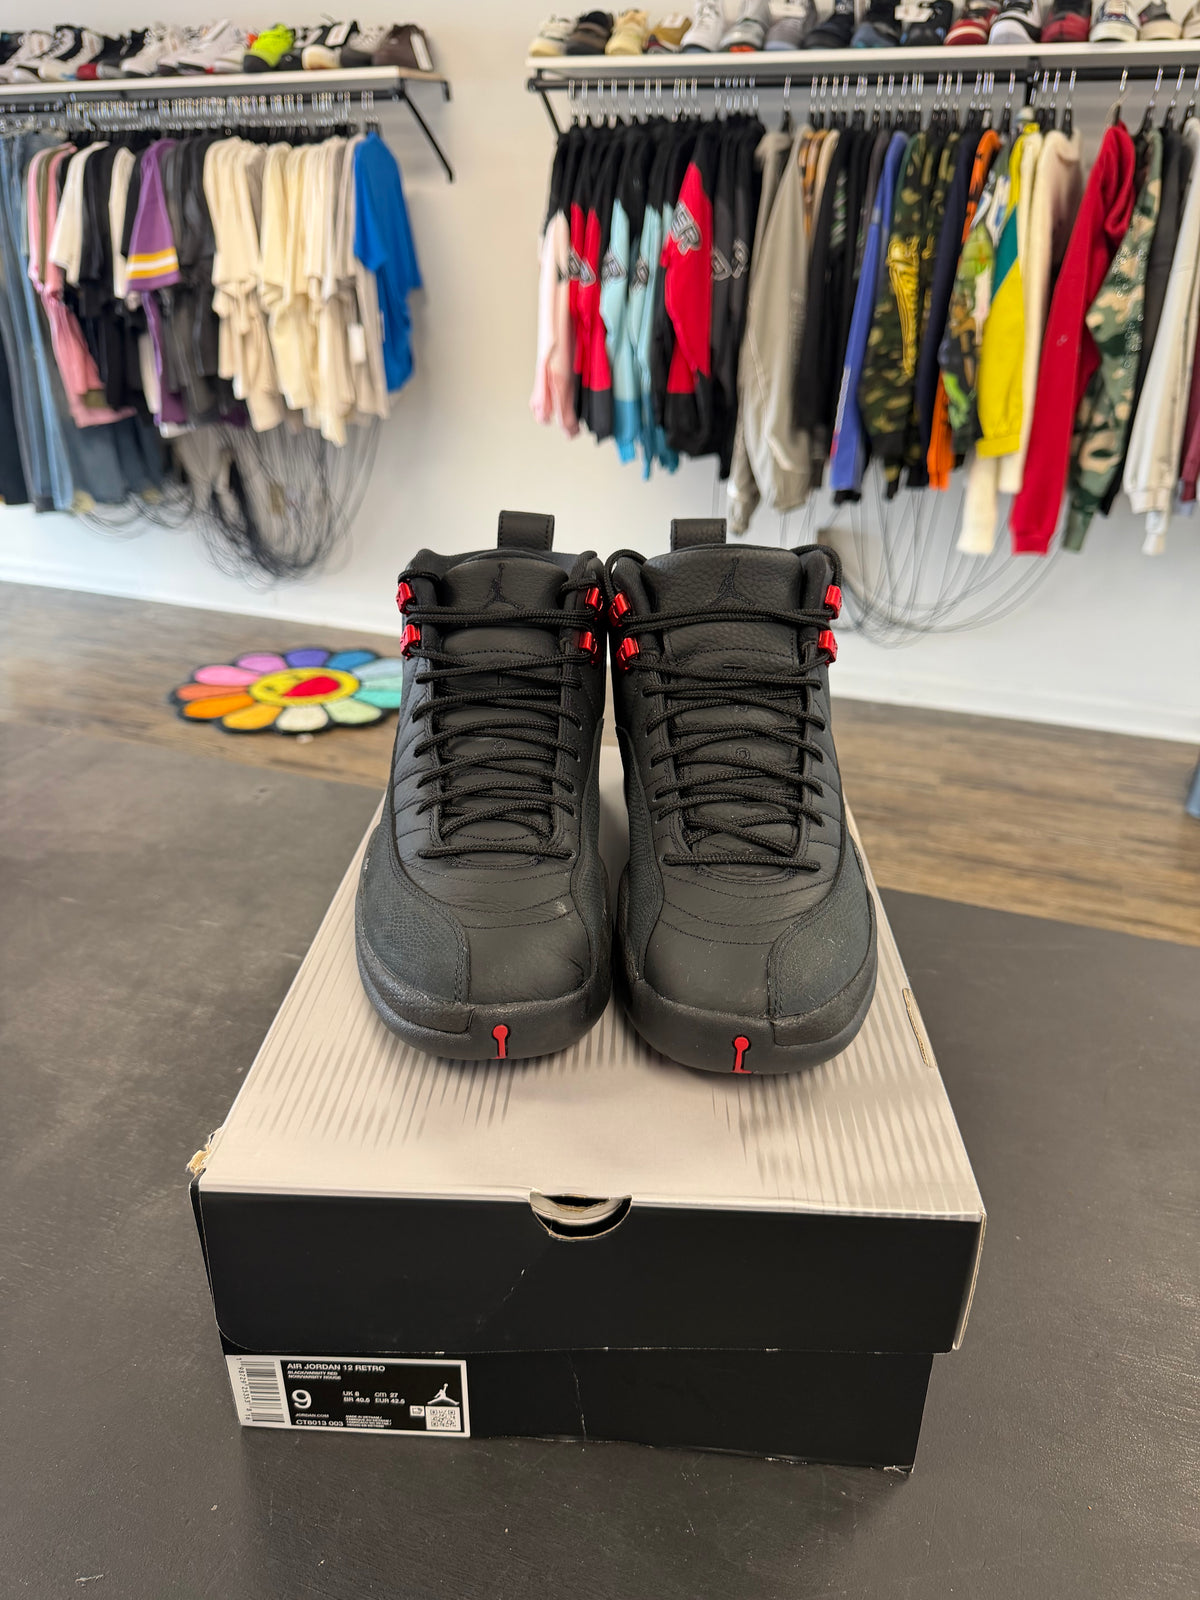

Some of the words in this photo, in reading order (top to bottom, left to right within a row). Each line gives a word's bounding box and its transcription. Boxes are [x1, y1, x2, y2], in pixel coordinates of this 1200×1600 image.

[287, 1362, 303, 1370] AIR
[304, 1362, 341, 1371] JORDAN
[355, 1364, 386, 1372] RETRO
[291, 1389, 312, 1409] 9
